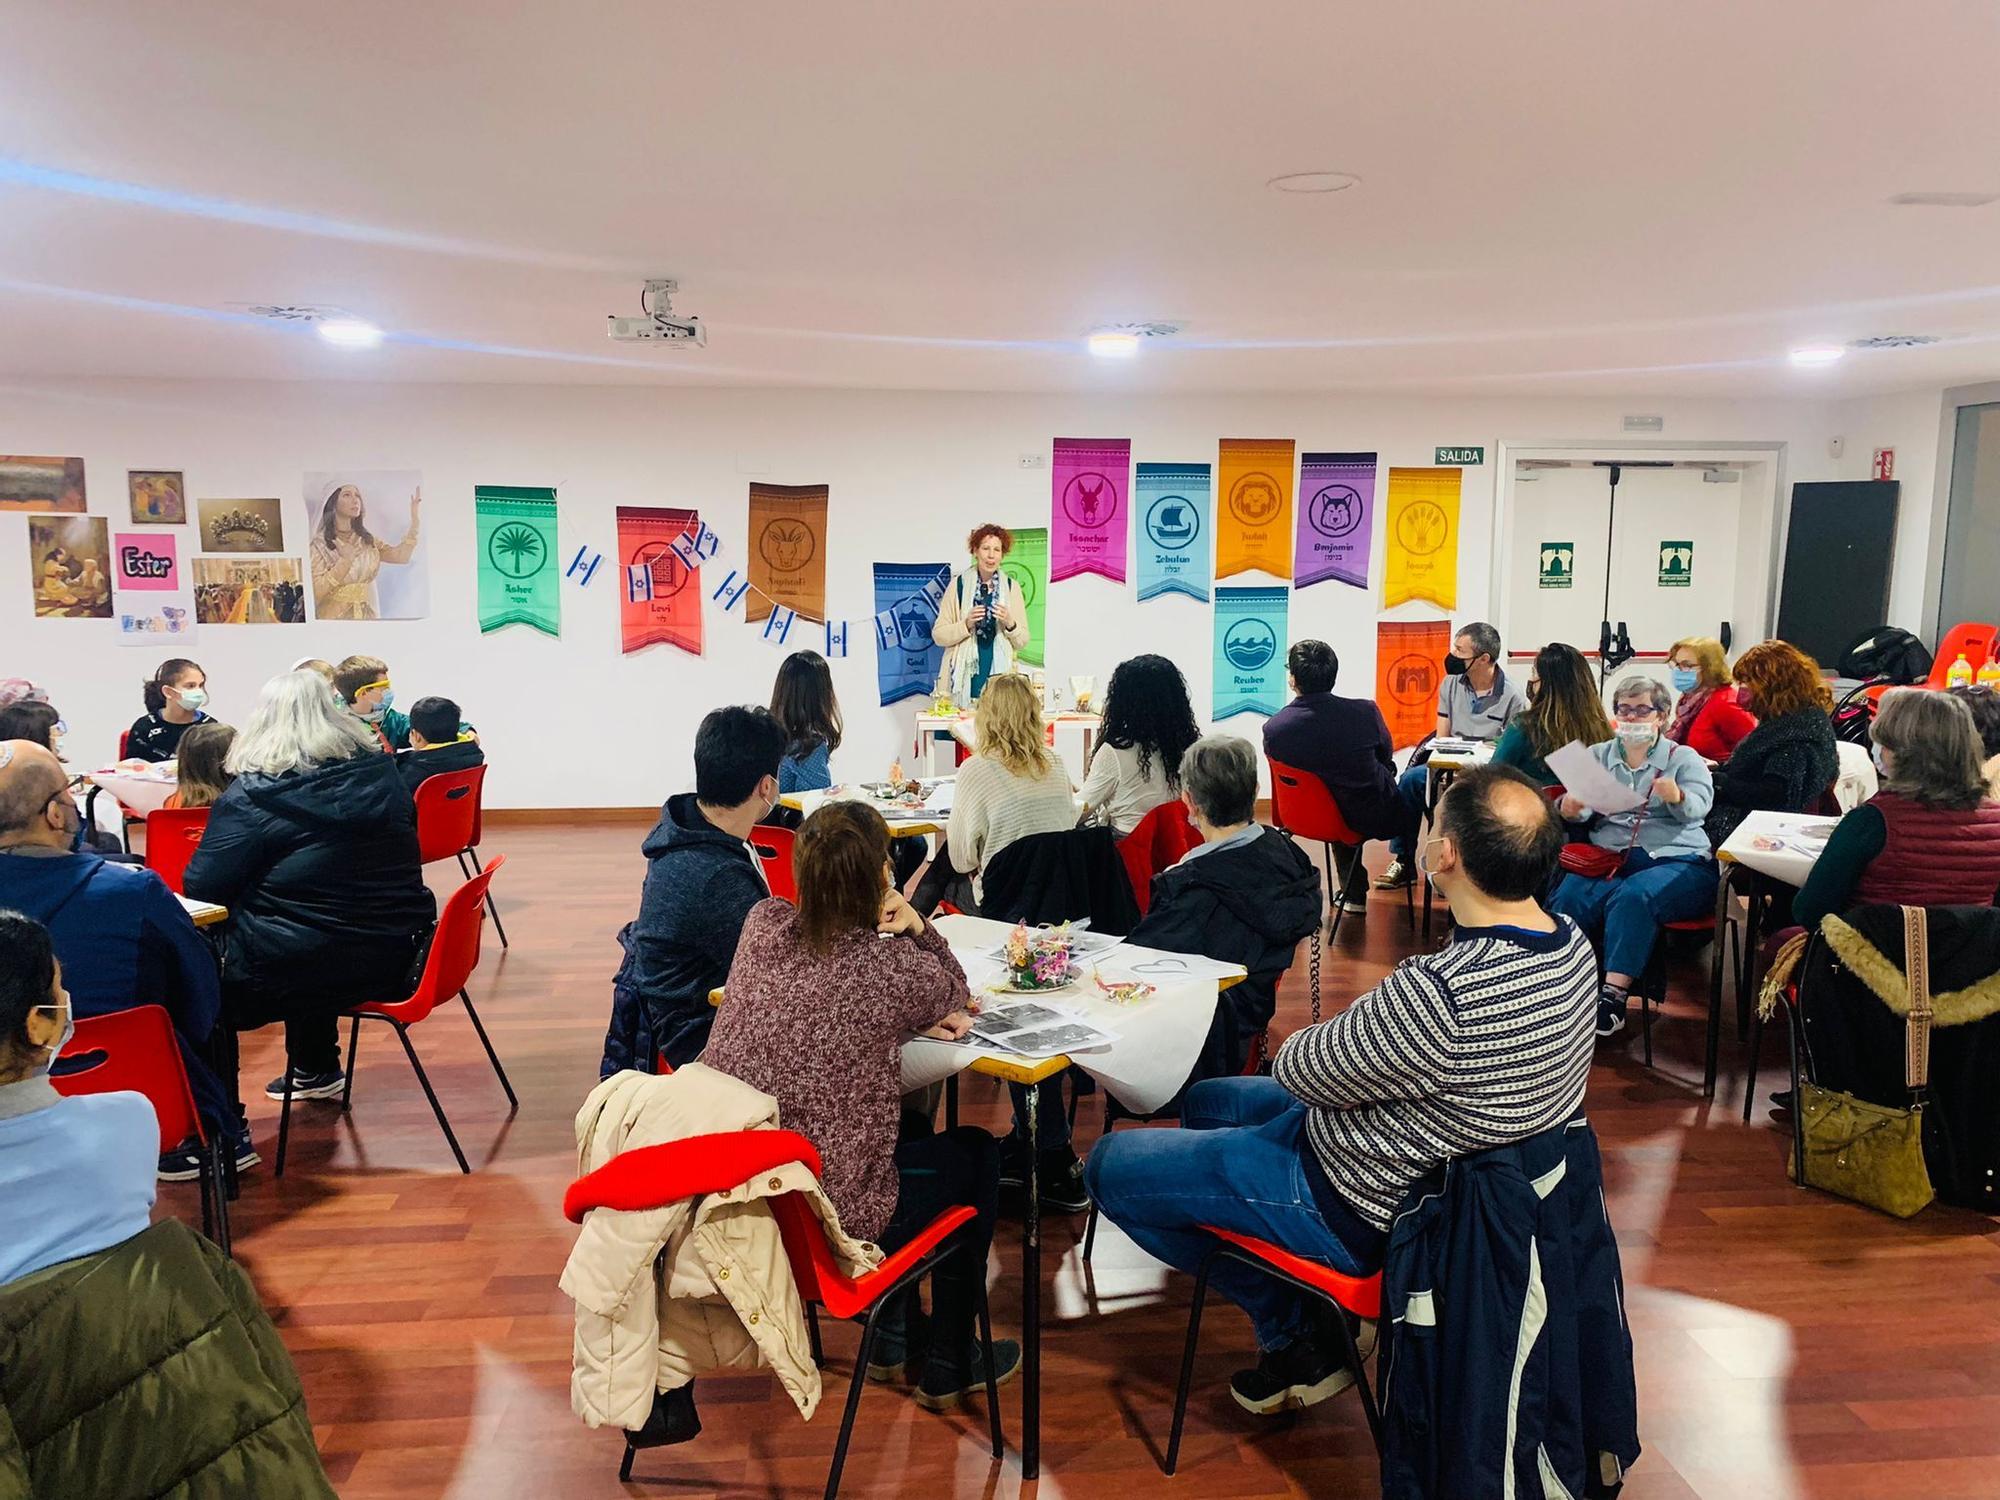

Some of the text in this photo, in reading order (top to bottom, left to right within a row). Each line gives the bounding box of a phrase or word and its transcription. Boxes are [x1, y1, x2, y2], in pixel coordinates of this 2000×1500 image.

[1439, 450, 1480, 464] SALIDA
[1314, 543, 1354, 554] Benjamin
[122, 546, 172, 577] Ester
[1155, 554, 1191, 564] Zebulun
[651, 603, 671, 613] Levi
[906, 657, 925, 666] Gad
[1234, 675, 1265, 685] Reuben
